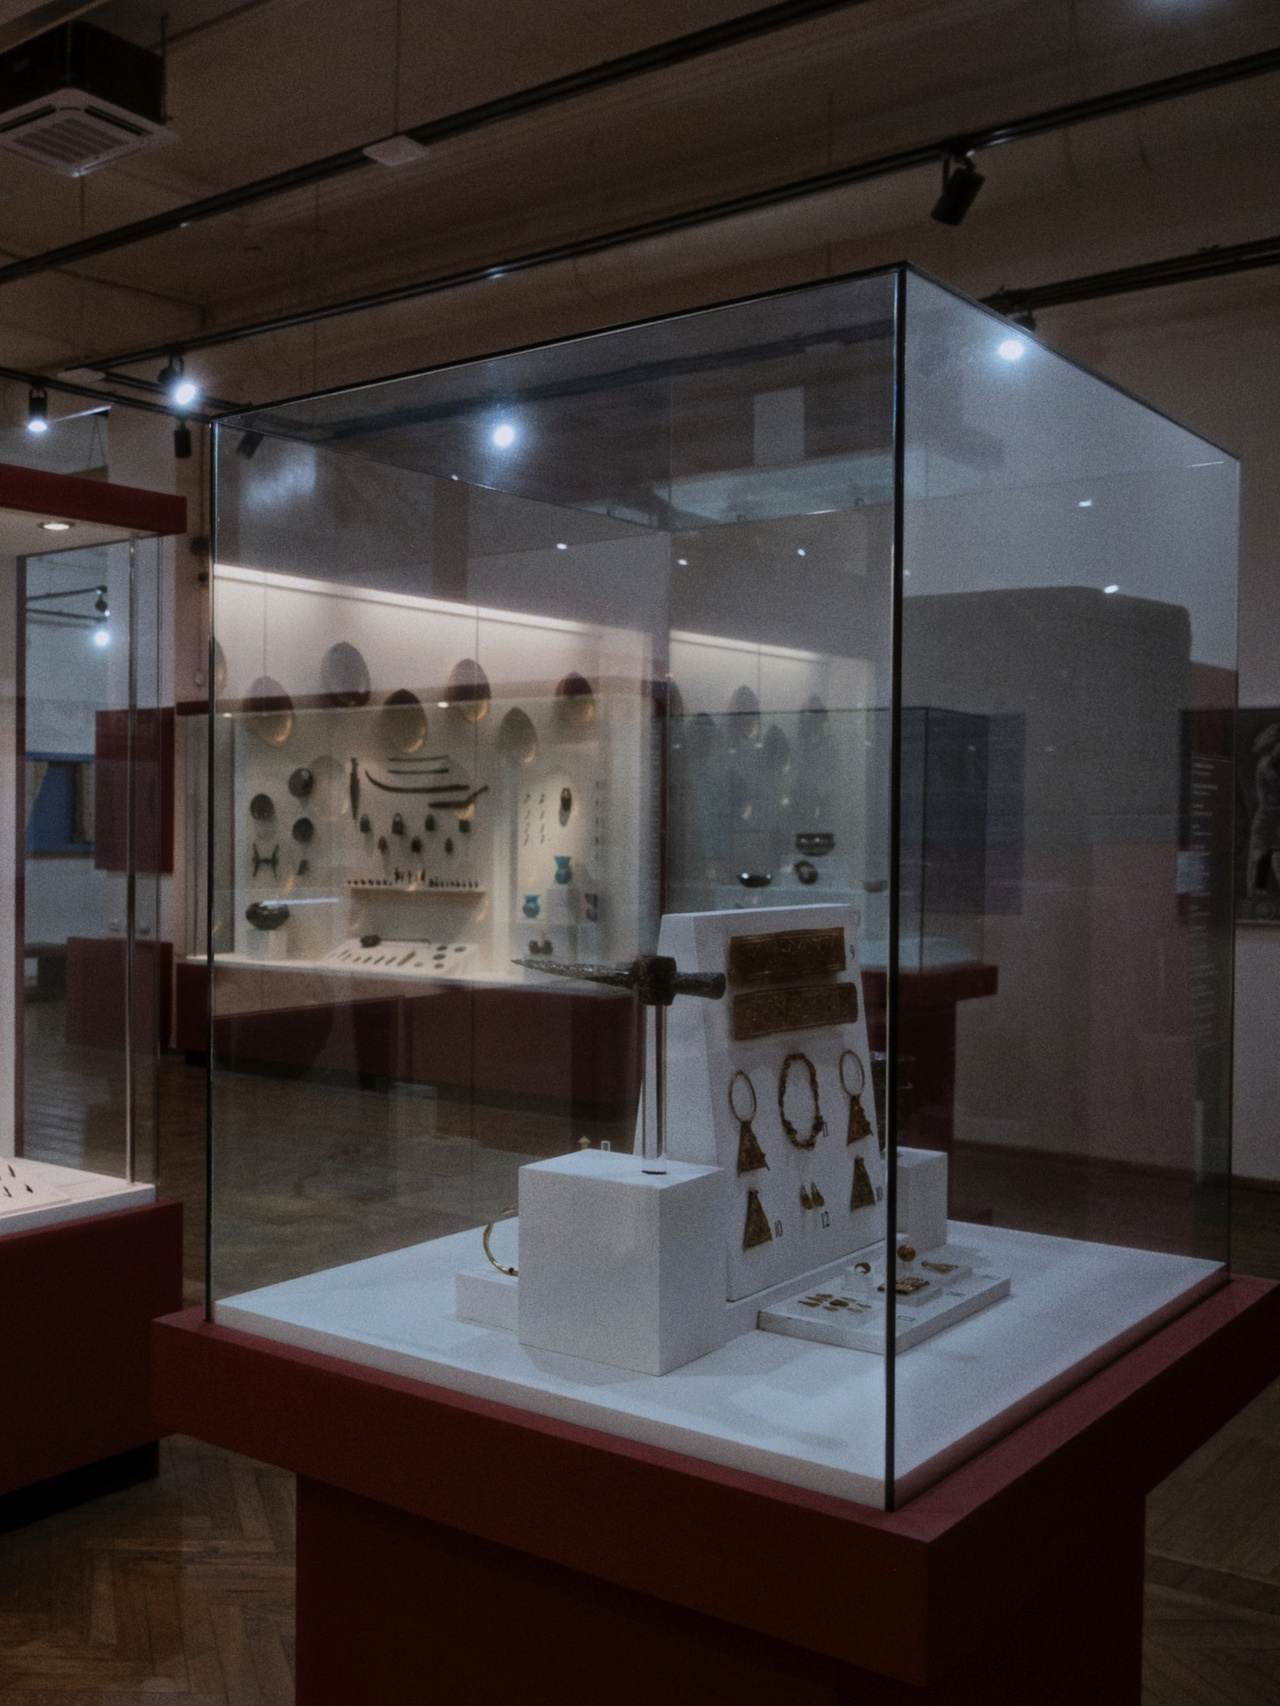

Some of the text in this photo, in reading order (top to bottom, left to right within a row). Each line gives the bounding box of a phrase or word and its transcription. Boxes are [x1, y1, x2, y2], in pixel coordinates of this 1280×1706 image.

[849, 944, 855, 960] 9
[821, 1211, 830, 1228] 12
[774, 1220, 782, 1238] 10
